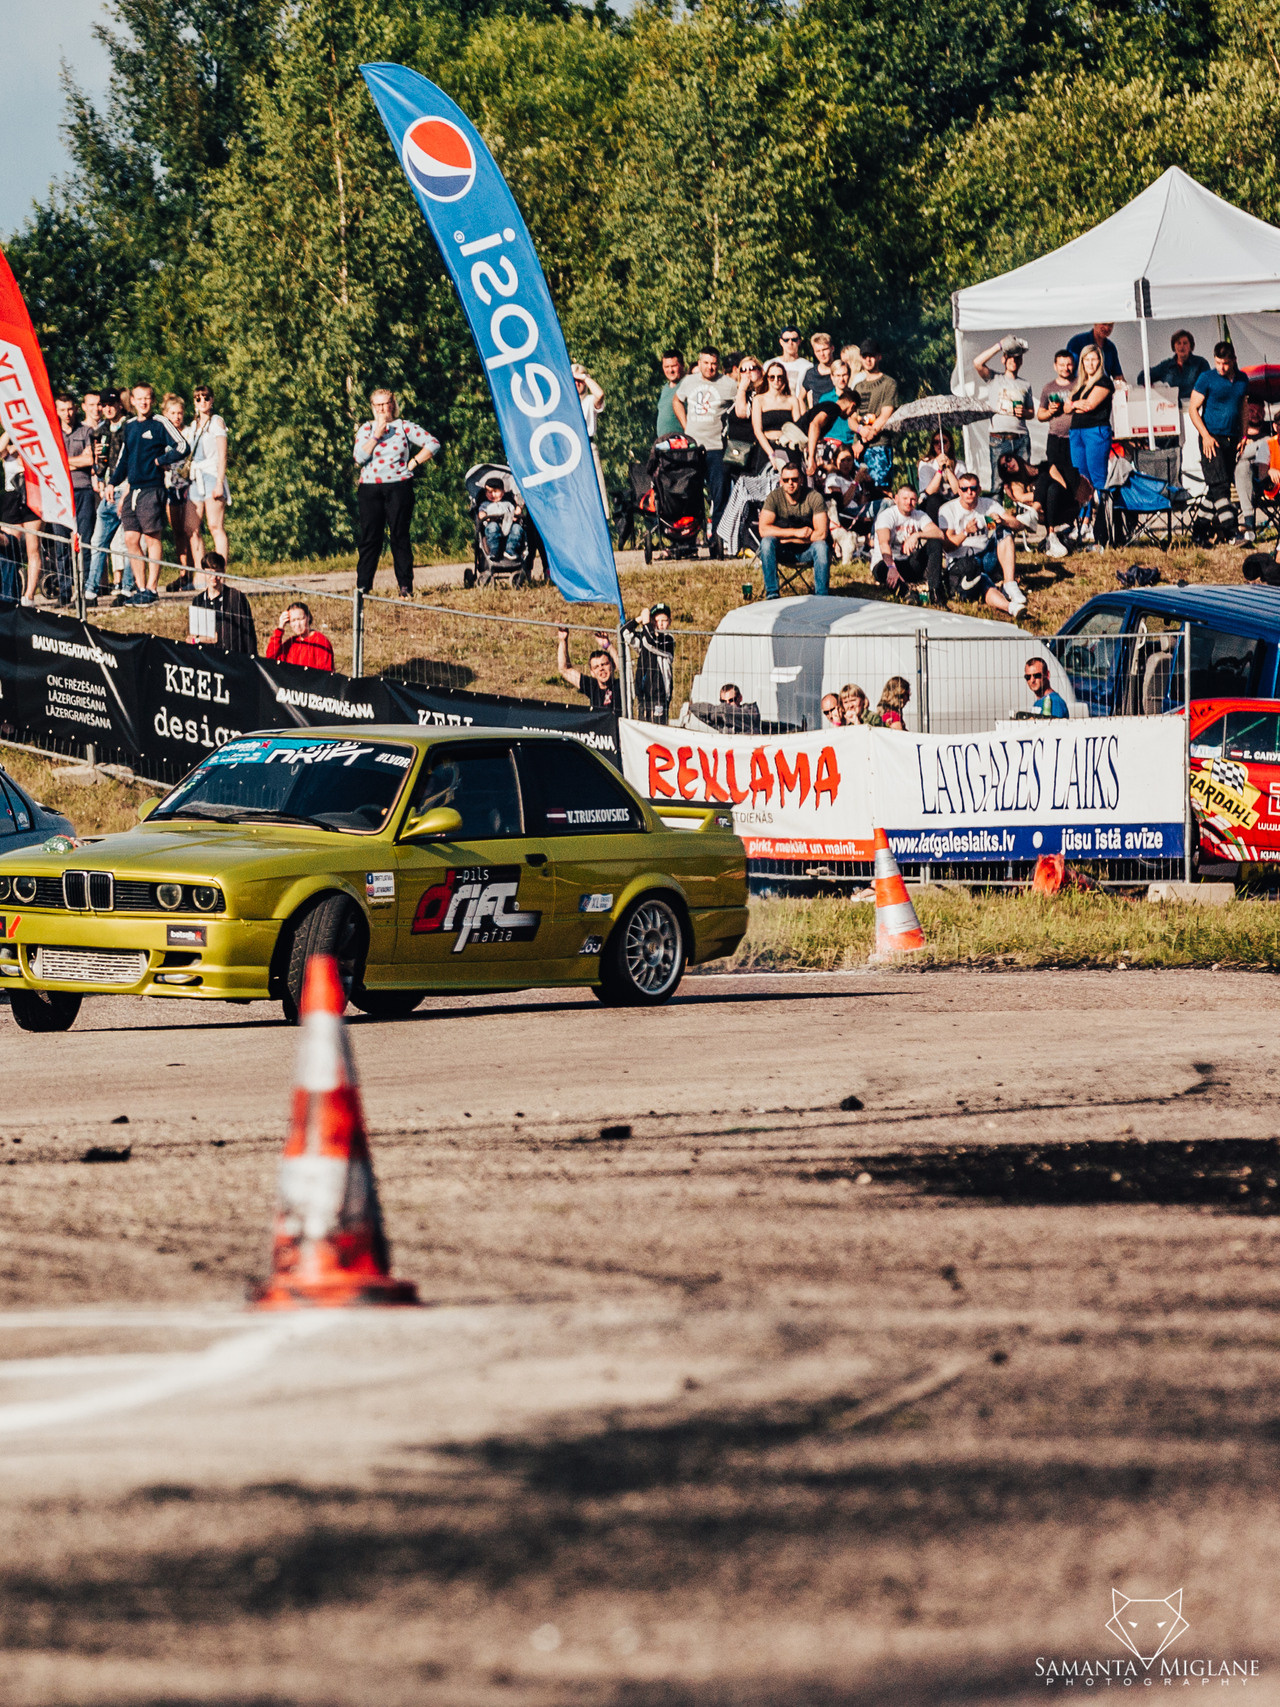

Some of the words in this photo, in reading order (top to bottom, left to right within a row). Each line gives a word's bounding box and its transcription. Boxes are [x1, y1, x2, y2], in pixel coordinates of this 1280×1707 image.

[47, 674, 64, 688] CNC
[163, 663, 230, 704] KEEL
[276, 687, 308, 708] BALVU
[646, 742, 841, 811] REKLAMA
[916, 738, 1045, 814] LATGALES
[1050, 734, 1120, 811] LAIKS
[566, 808, 629, 824] V.TRUSKOVSKIS
[734, 810, 773, 824] TDIENĀS
[749, 840, 773, 856] pirkt,
[811, 843, 823, 855] un
[888, 829, 1015, 858] www.latgaleslaiks.lv
[472, 928, 512, 942] mafia
